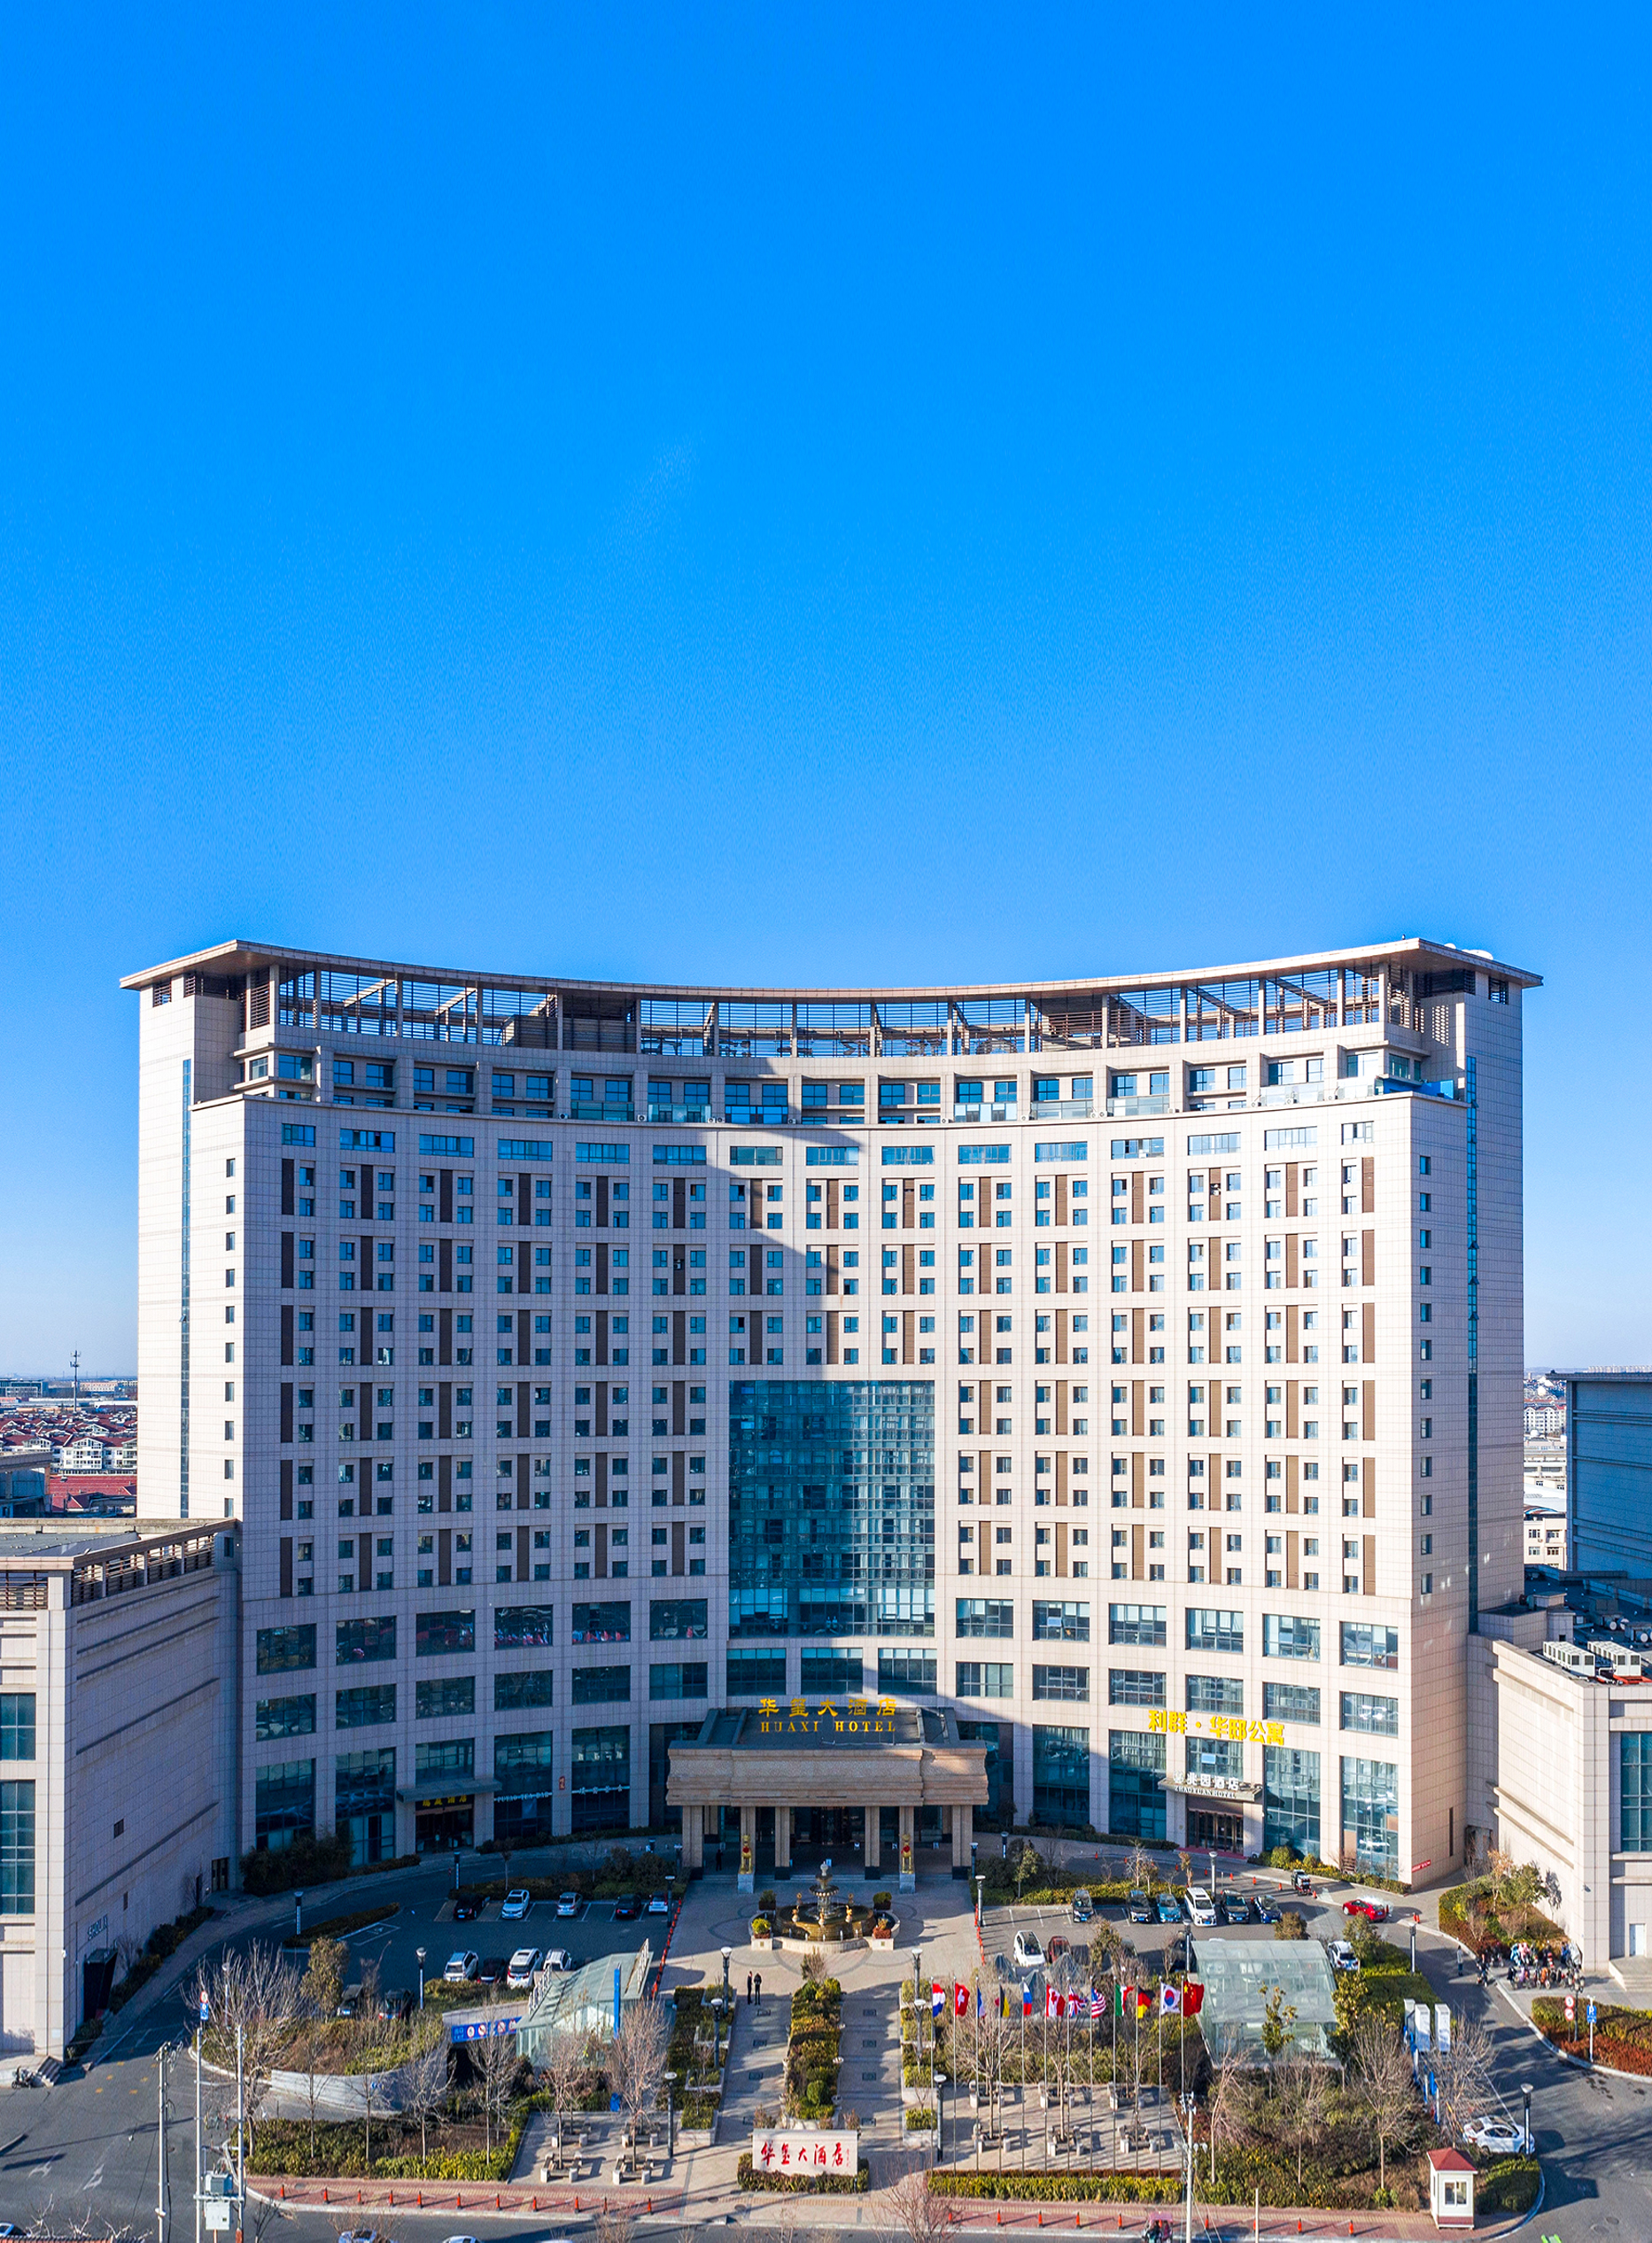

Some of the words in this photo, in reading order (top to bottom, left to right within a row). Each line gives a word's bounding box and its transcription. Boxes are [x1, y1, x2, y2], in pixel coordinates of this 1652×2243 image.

[758, 1697, 897, 1718] 华玺大酒店
[761, 1721, 818, 1733] HUAXI
[835, 1720, 896, 1733] HOTEL
[761, 2140, 843, 2167] 华玺大酒店
